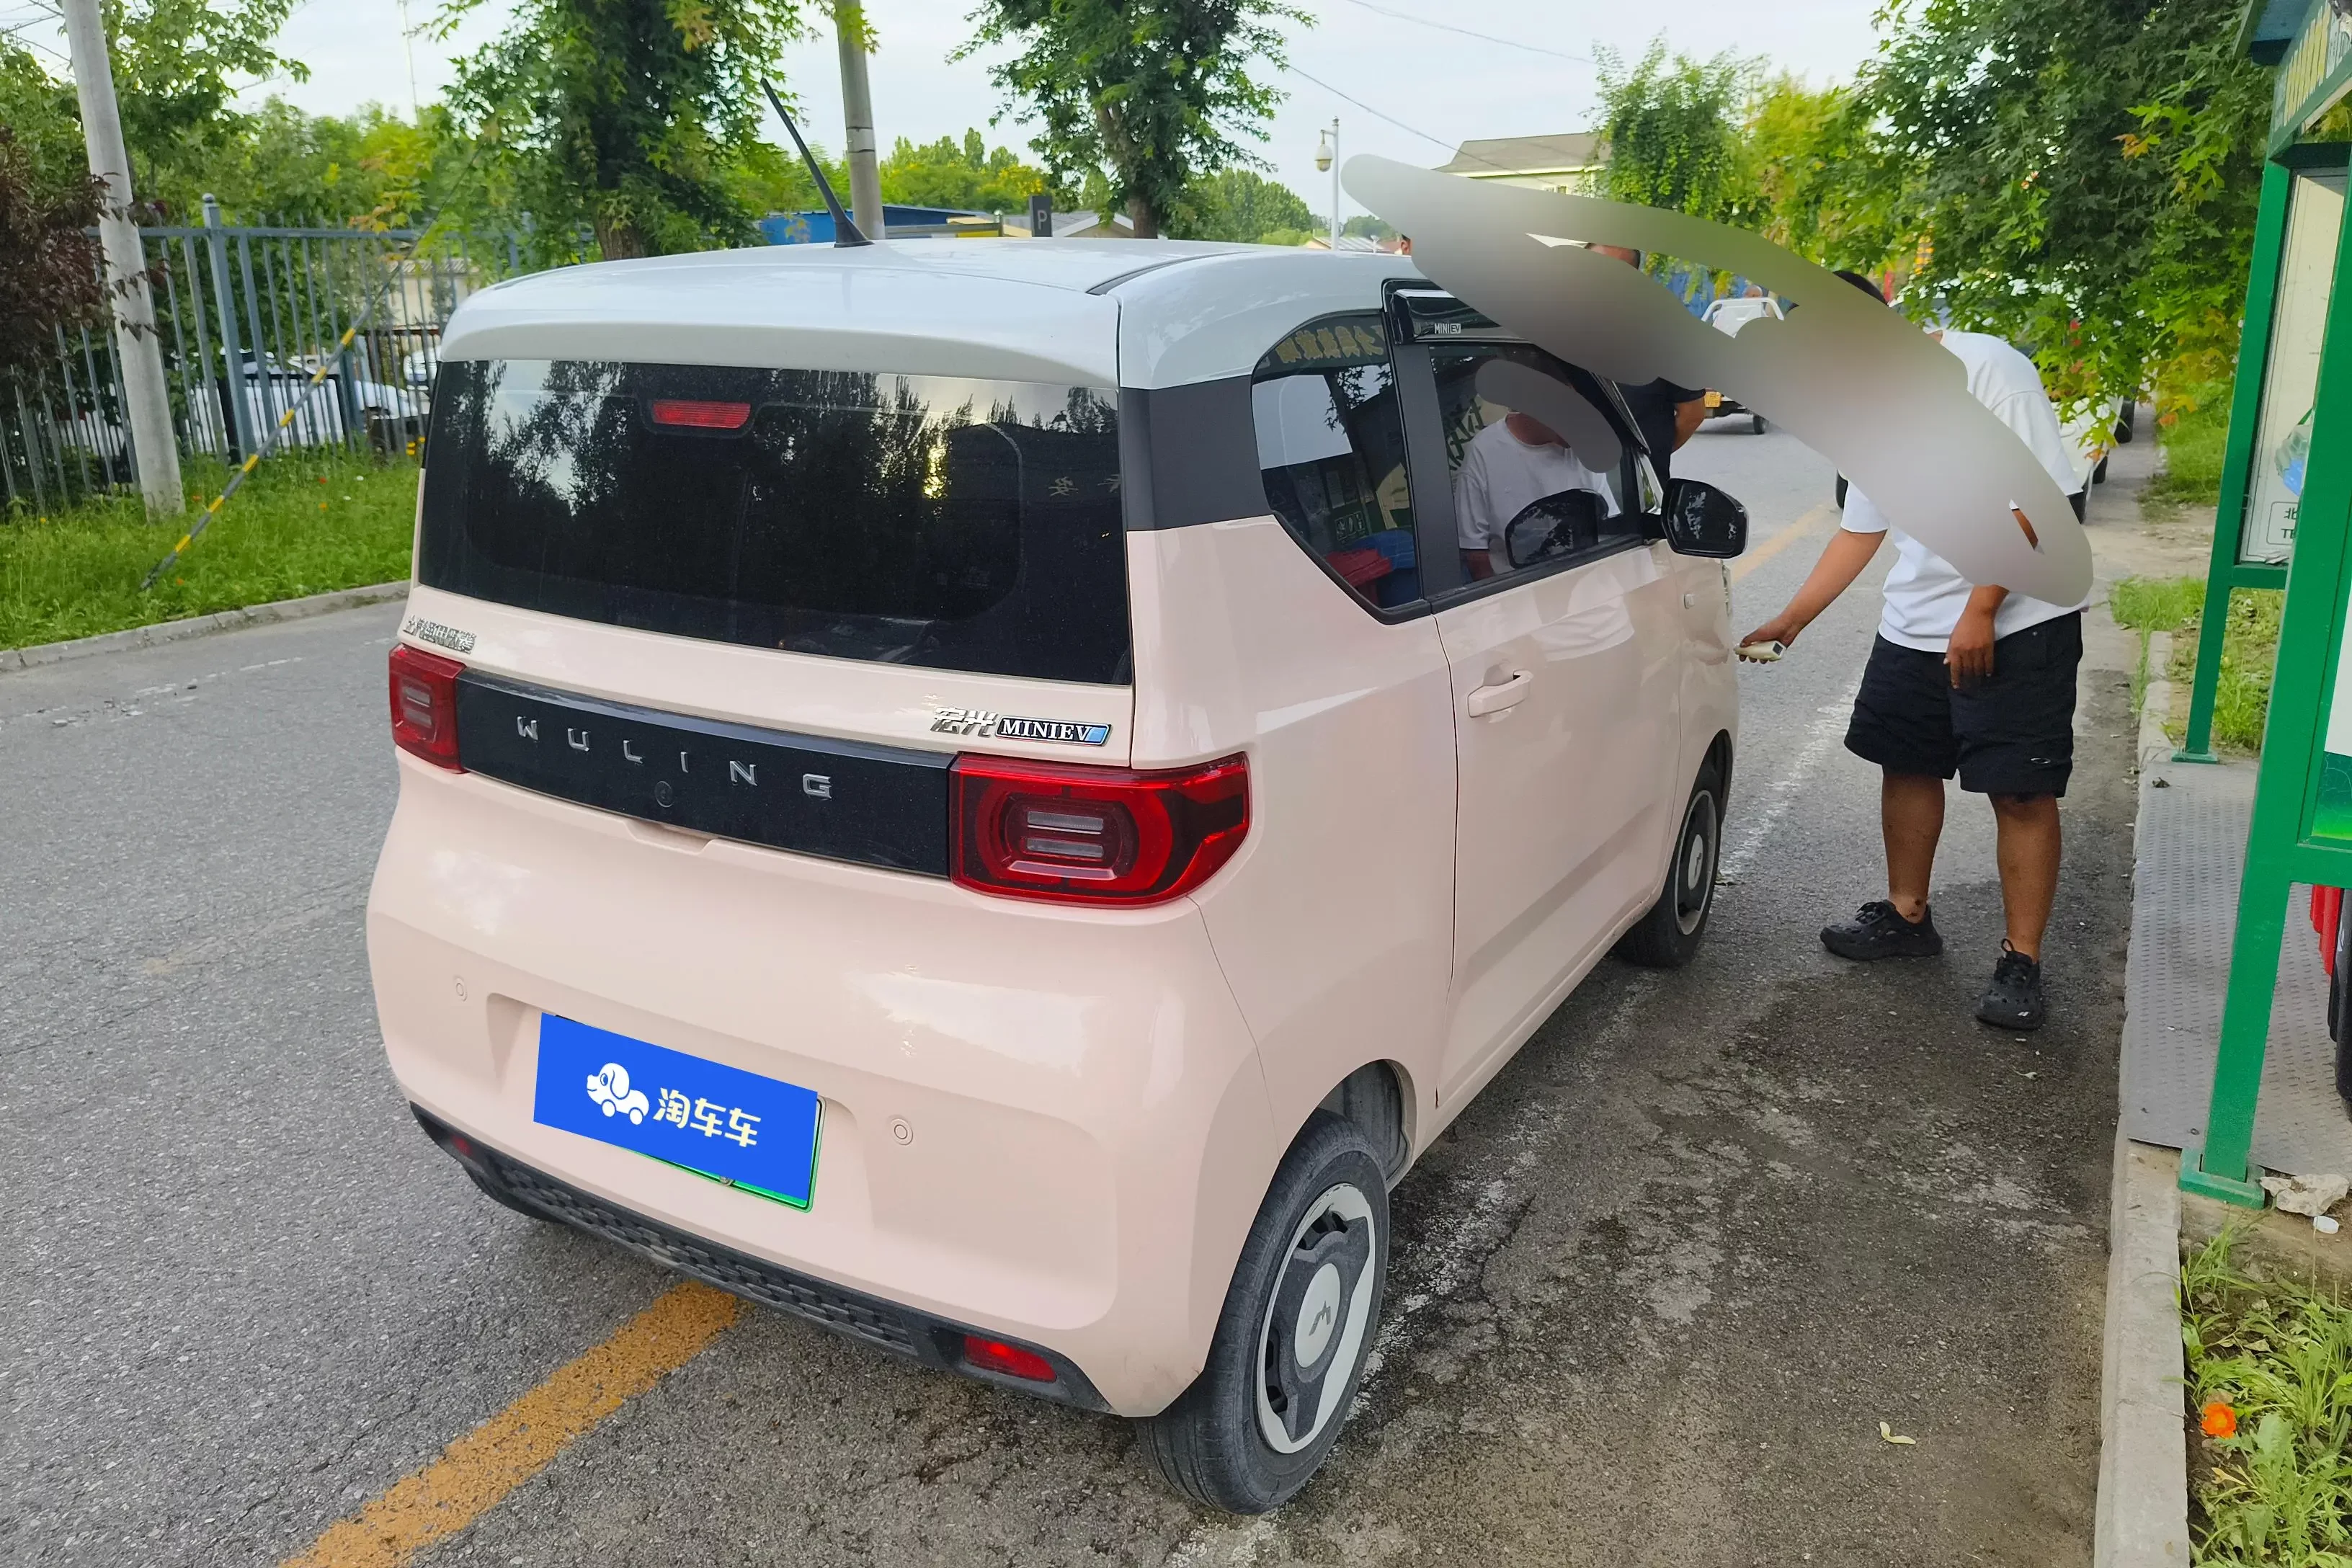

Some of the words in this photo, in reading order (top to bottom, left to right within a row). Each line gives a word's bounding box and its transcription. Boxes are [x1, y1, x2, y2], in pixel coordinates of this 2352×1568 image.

[1038, 210, 1048, 231] P
[930, 706, 998, 737] 宏光
[1000, 718, 1092, 742] MINIEV
[517, 715, 832, 799] WULING
